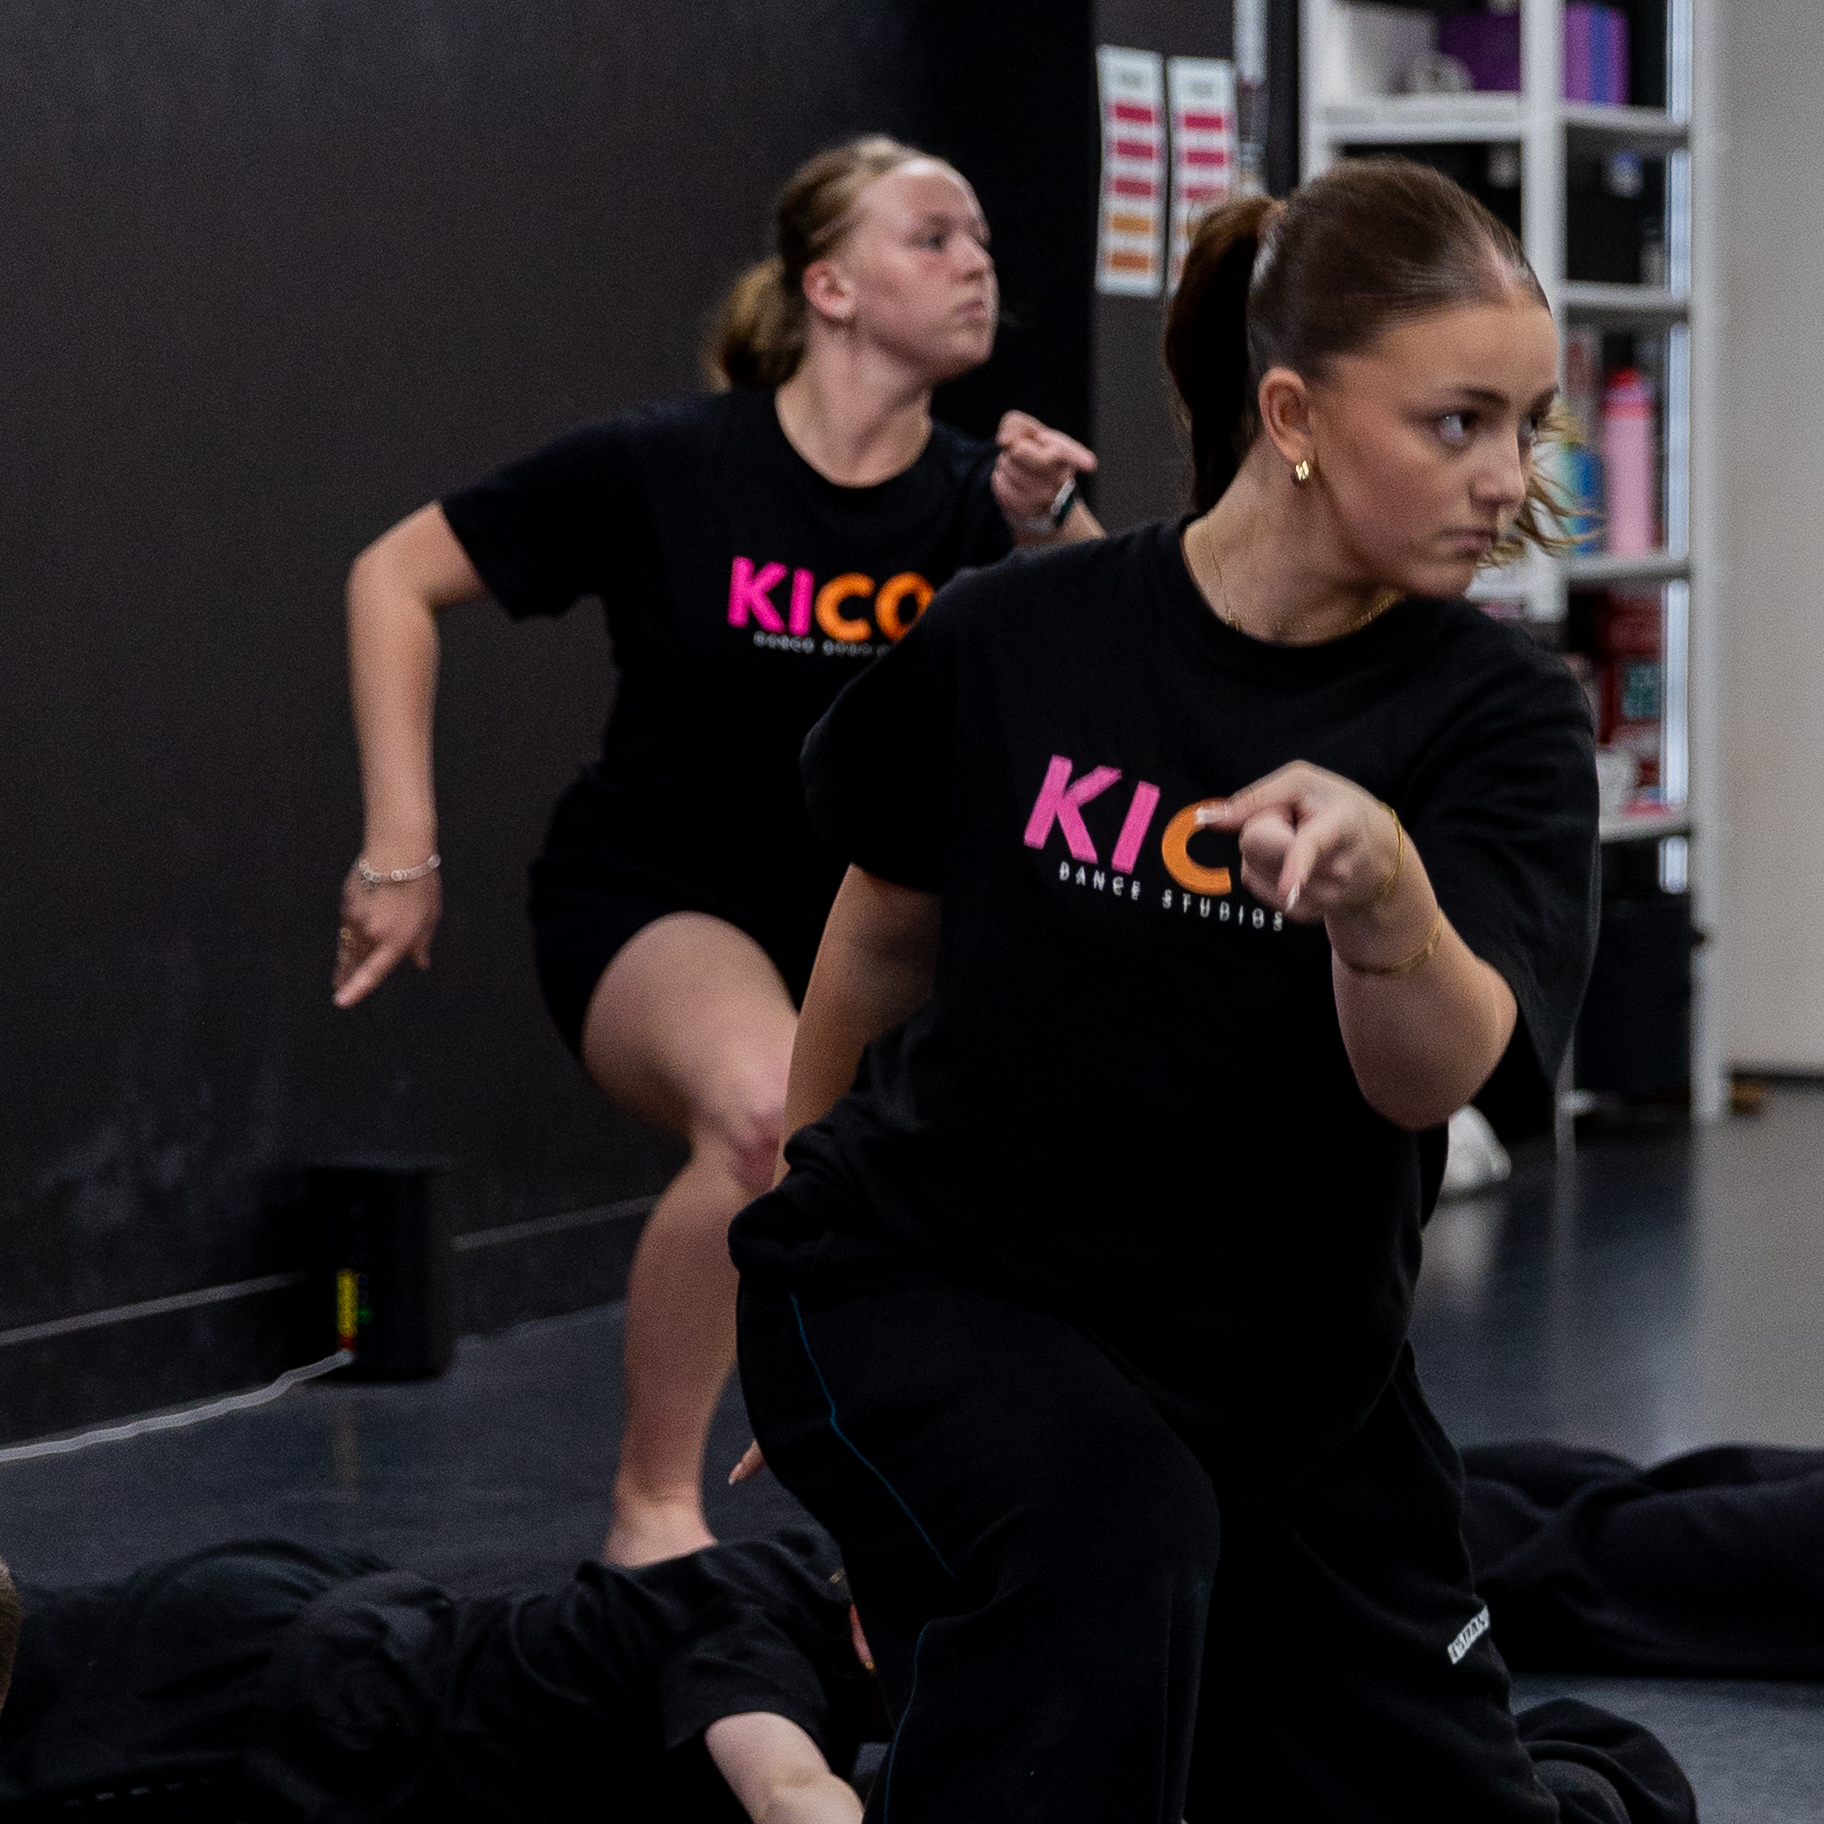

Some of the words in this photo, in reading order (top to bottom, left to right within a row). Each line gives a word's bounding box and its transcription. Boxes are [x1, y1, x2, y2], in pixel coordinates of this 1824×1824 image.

[727, 554, 936, 644] KICO
[1022, 753, 1233, 897] KIC
[1058, 860, 1142, 902] DANCE
[1161, 888, 1284, 933] STUDIOS
